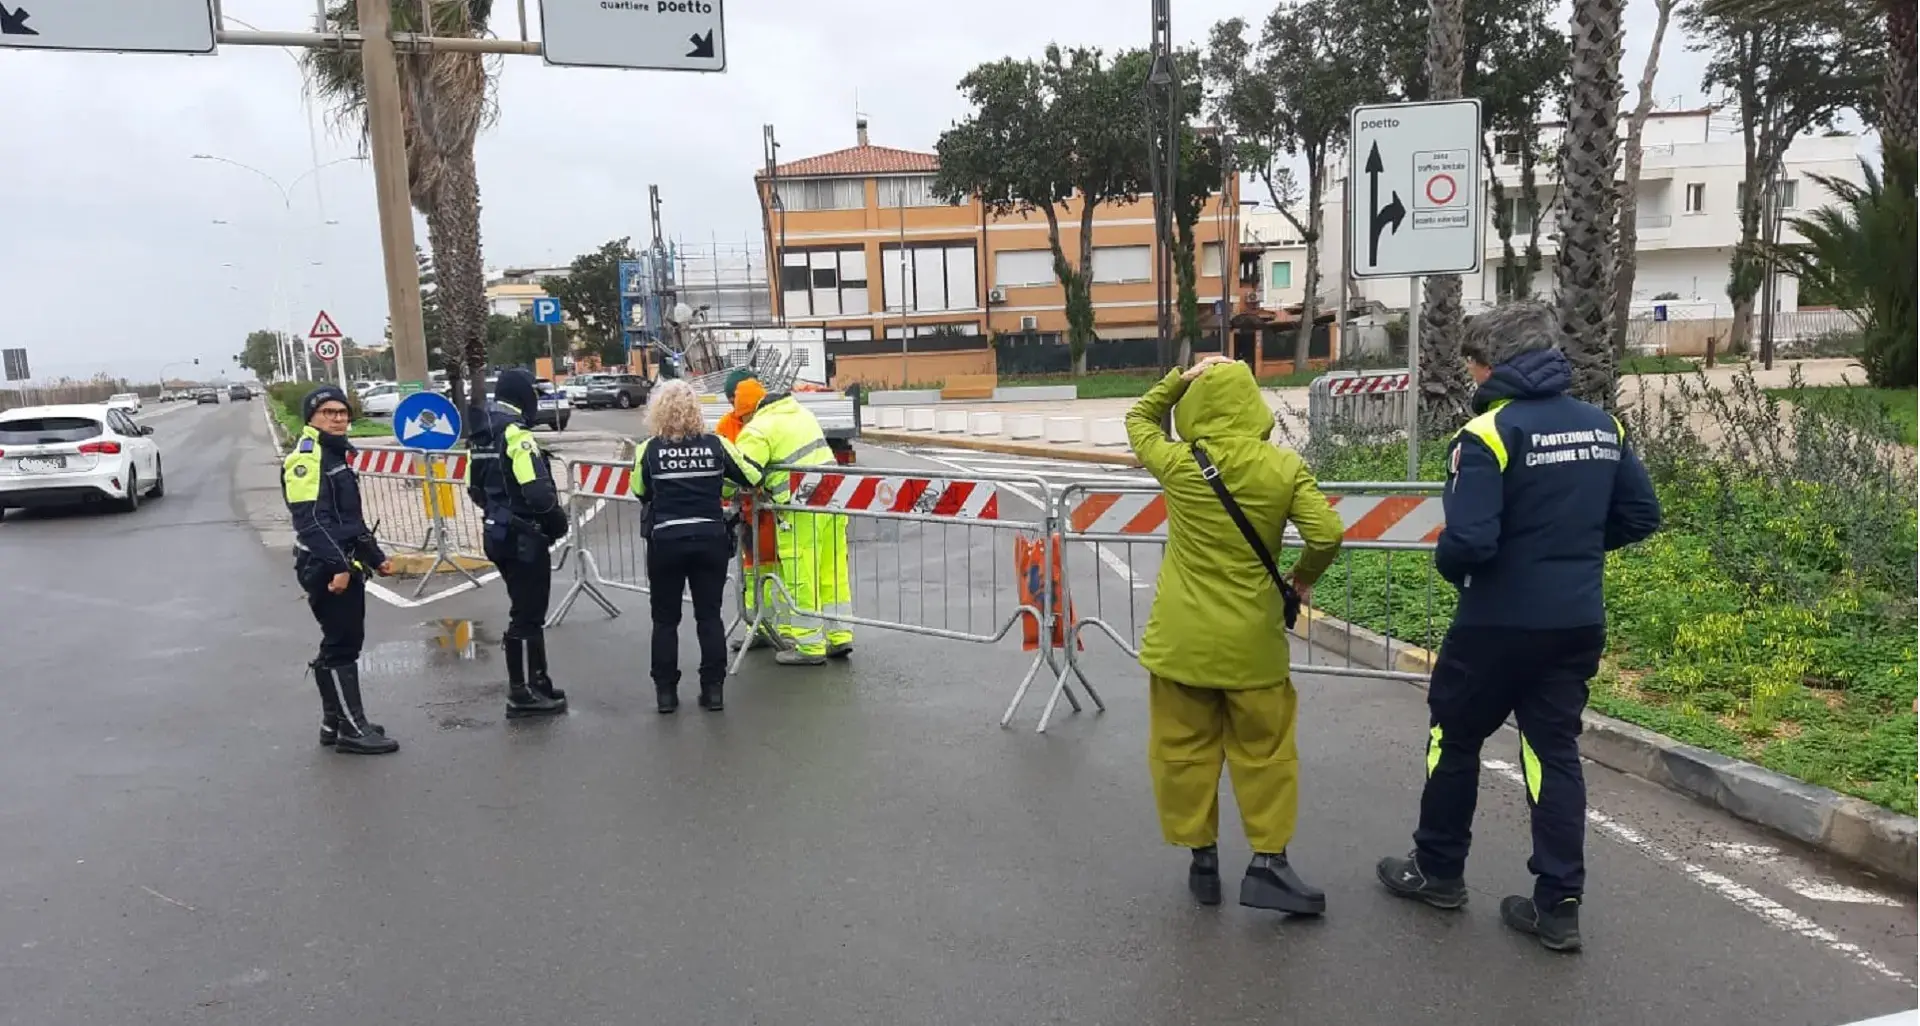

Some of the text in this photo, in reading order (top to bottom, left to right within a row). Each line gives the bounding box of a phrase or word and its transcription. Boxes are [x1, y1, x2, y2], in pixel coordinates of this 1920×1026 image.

[600, 0, 712, 13] quartiere poetto
[1361, 118, 1400, 131] poetto
[539, 301, 555, 321] P
[321, 344, 335, 355] 50
[658, 447, 713, 458] POLIZIA
[1526, 450, 1576, 466] COMUNE
[659, 458, 715, 470] LOCALE
